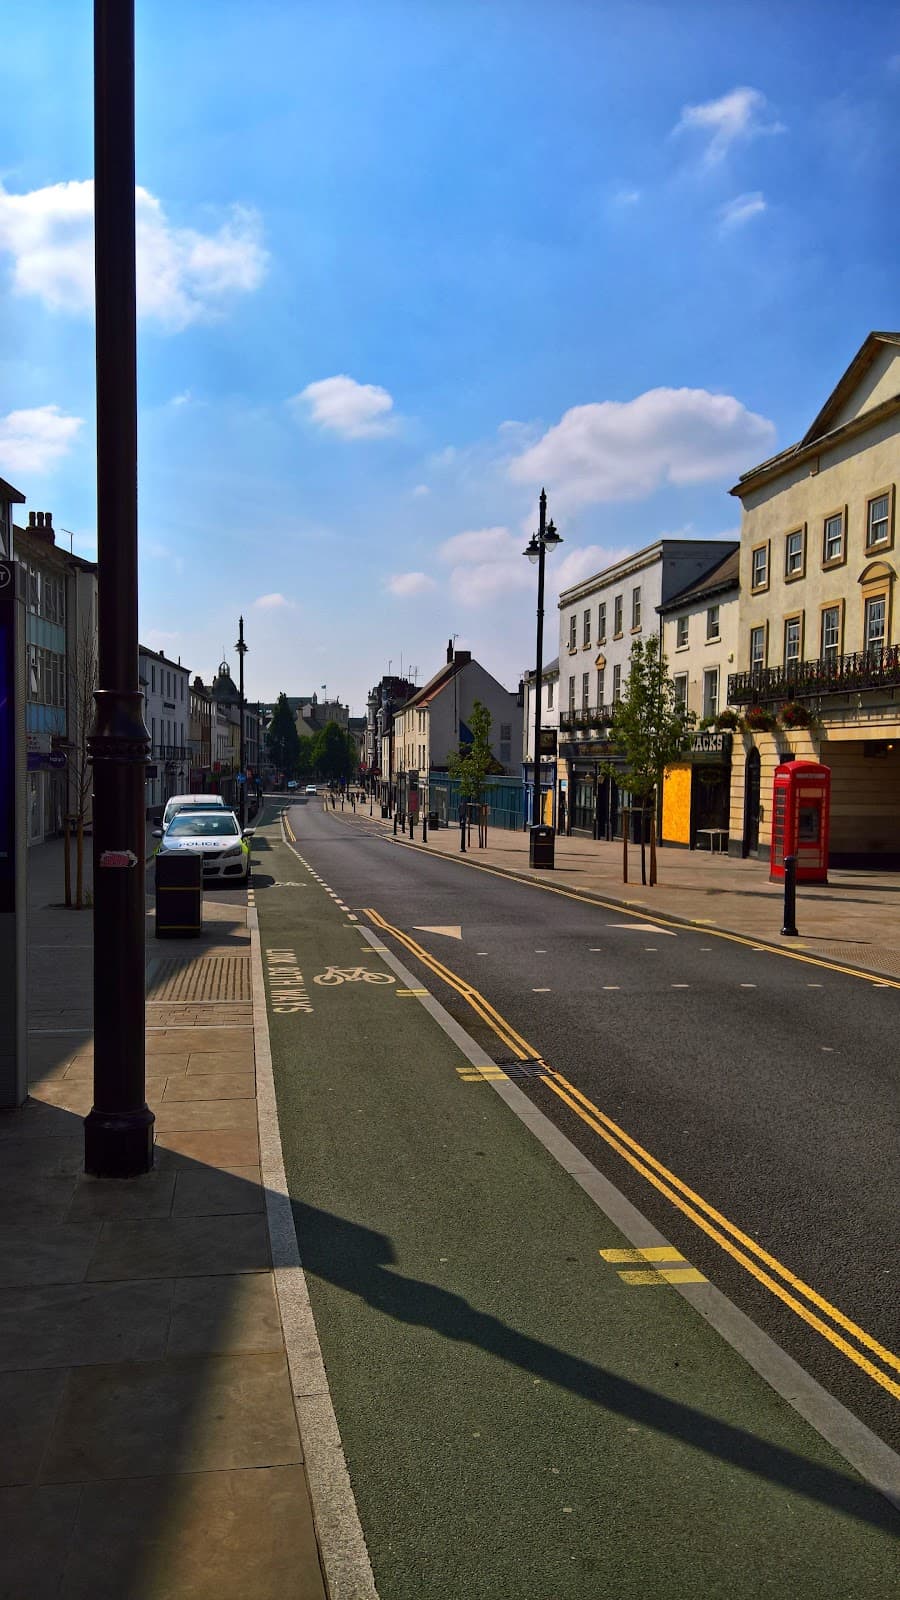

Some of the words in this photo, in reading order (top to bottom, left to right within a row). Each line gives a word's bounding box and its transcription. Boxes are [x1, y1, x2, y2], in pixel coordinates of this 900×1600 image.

[265, 948, 297, 964] LOOK
[267, 966, 304, 986] BOTH
[269, 988, 314, 1013] WAYS
